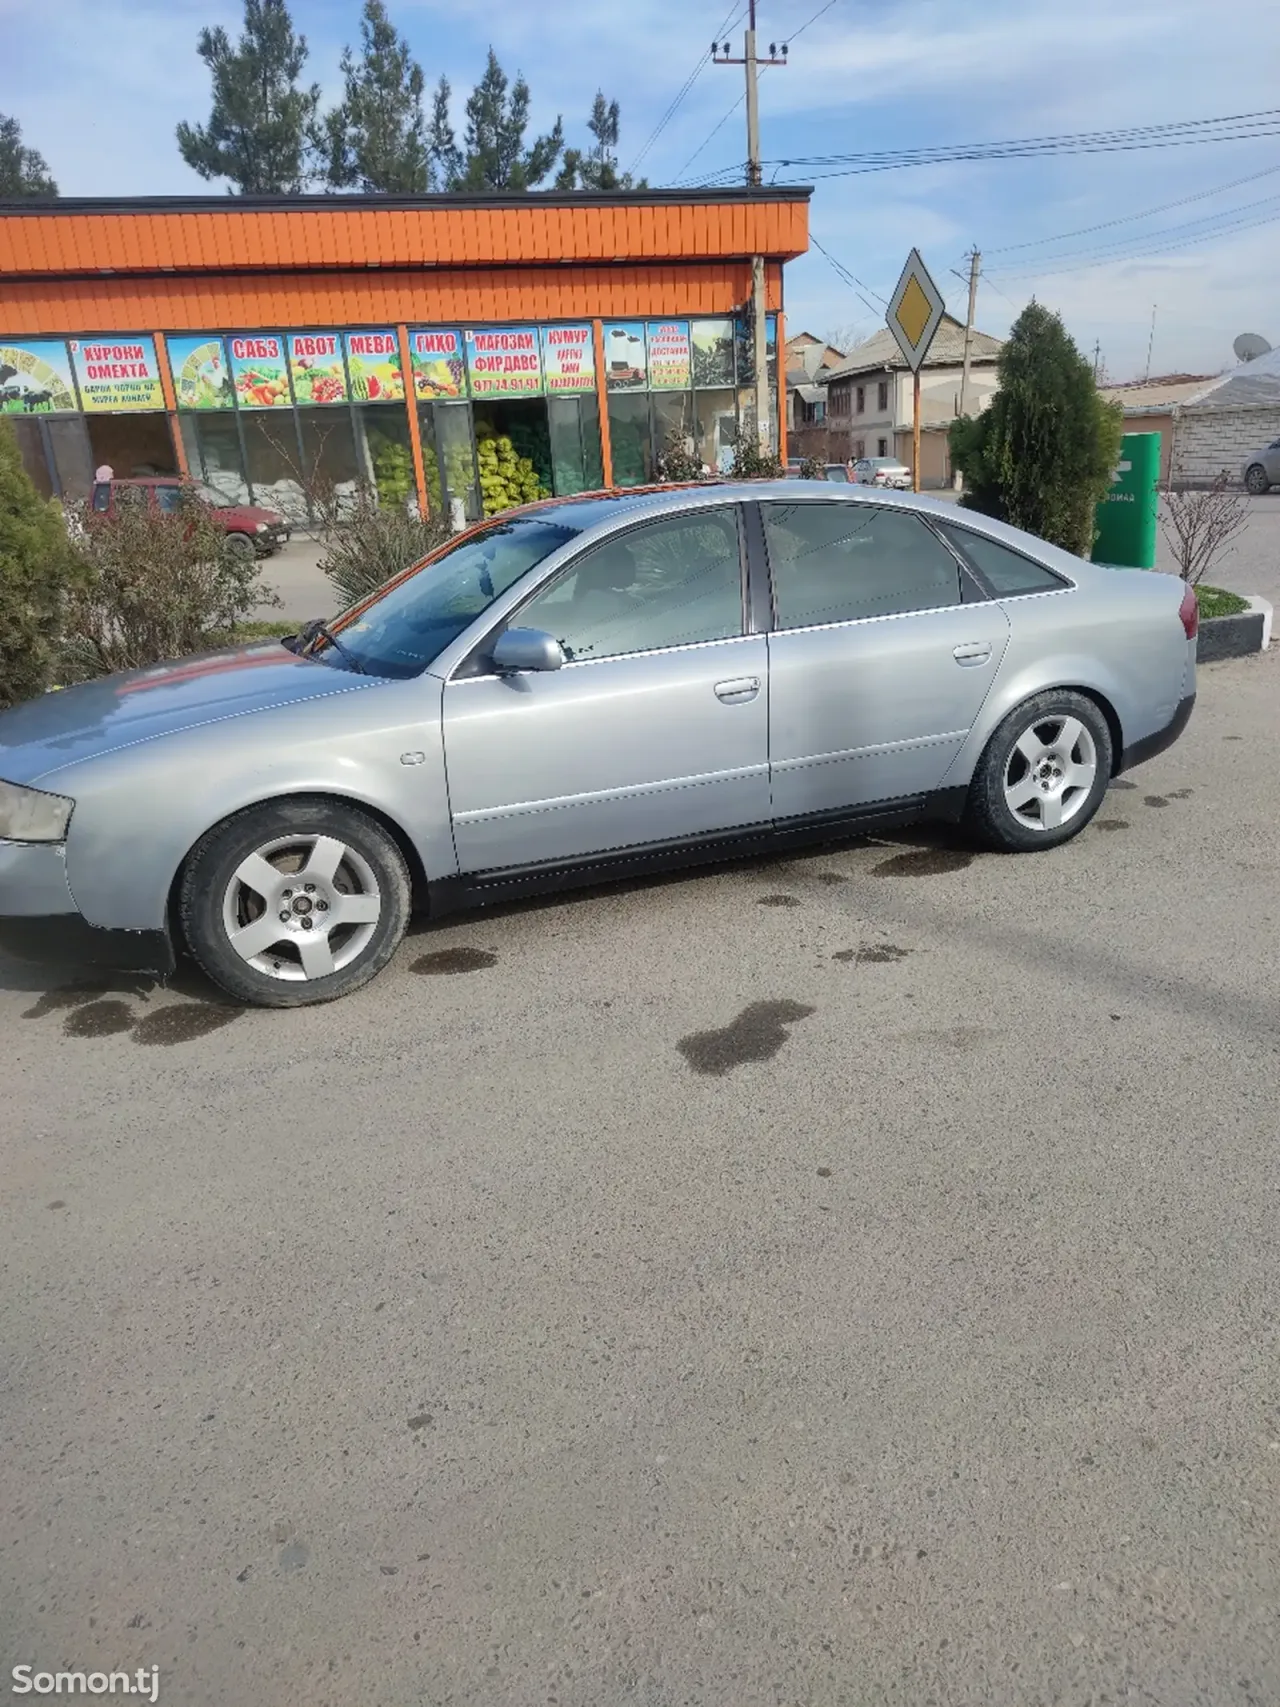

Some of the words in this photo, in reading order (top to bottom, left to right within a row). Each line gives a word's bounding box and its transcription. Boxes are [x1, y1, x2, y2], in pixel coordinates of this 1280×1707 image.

[233, 339, 279, 359] САБЗ
[294, 336, 336, 356] АВОТ
[350, 335, 396, 355] МЕВА
[475, 354, 538, 373] ФИРДАВС
